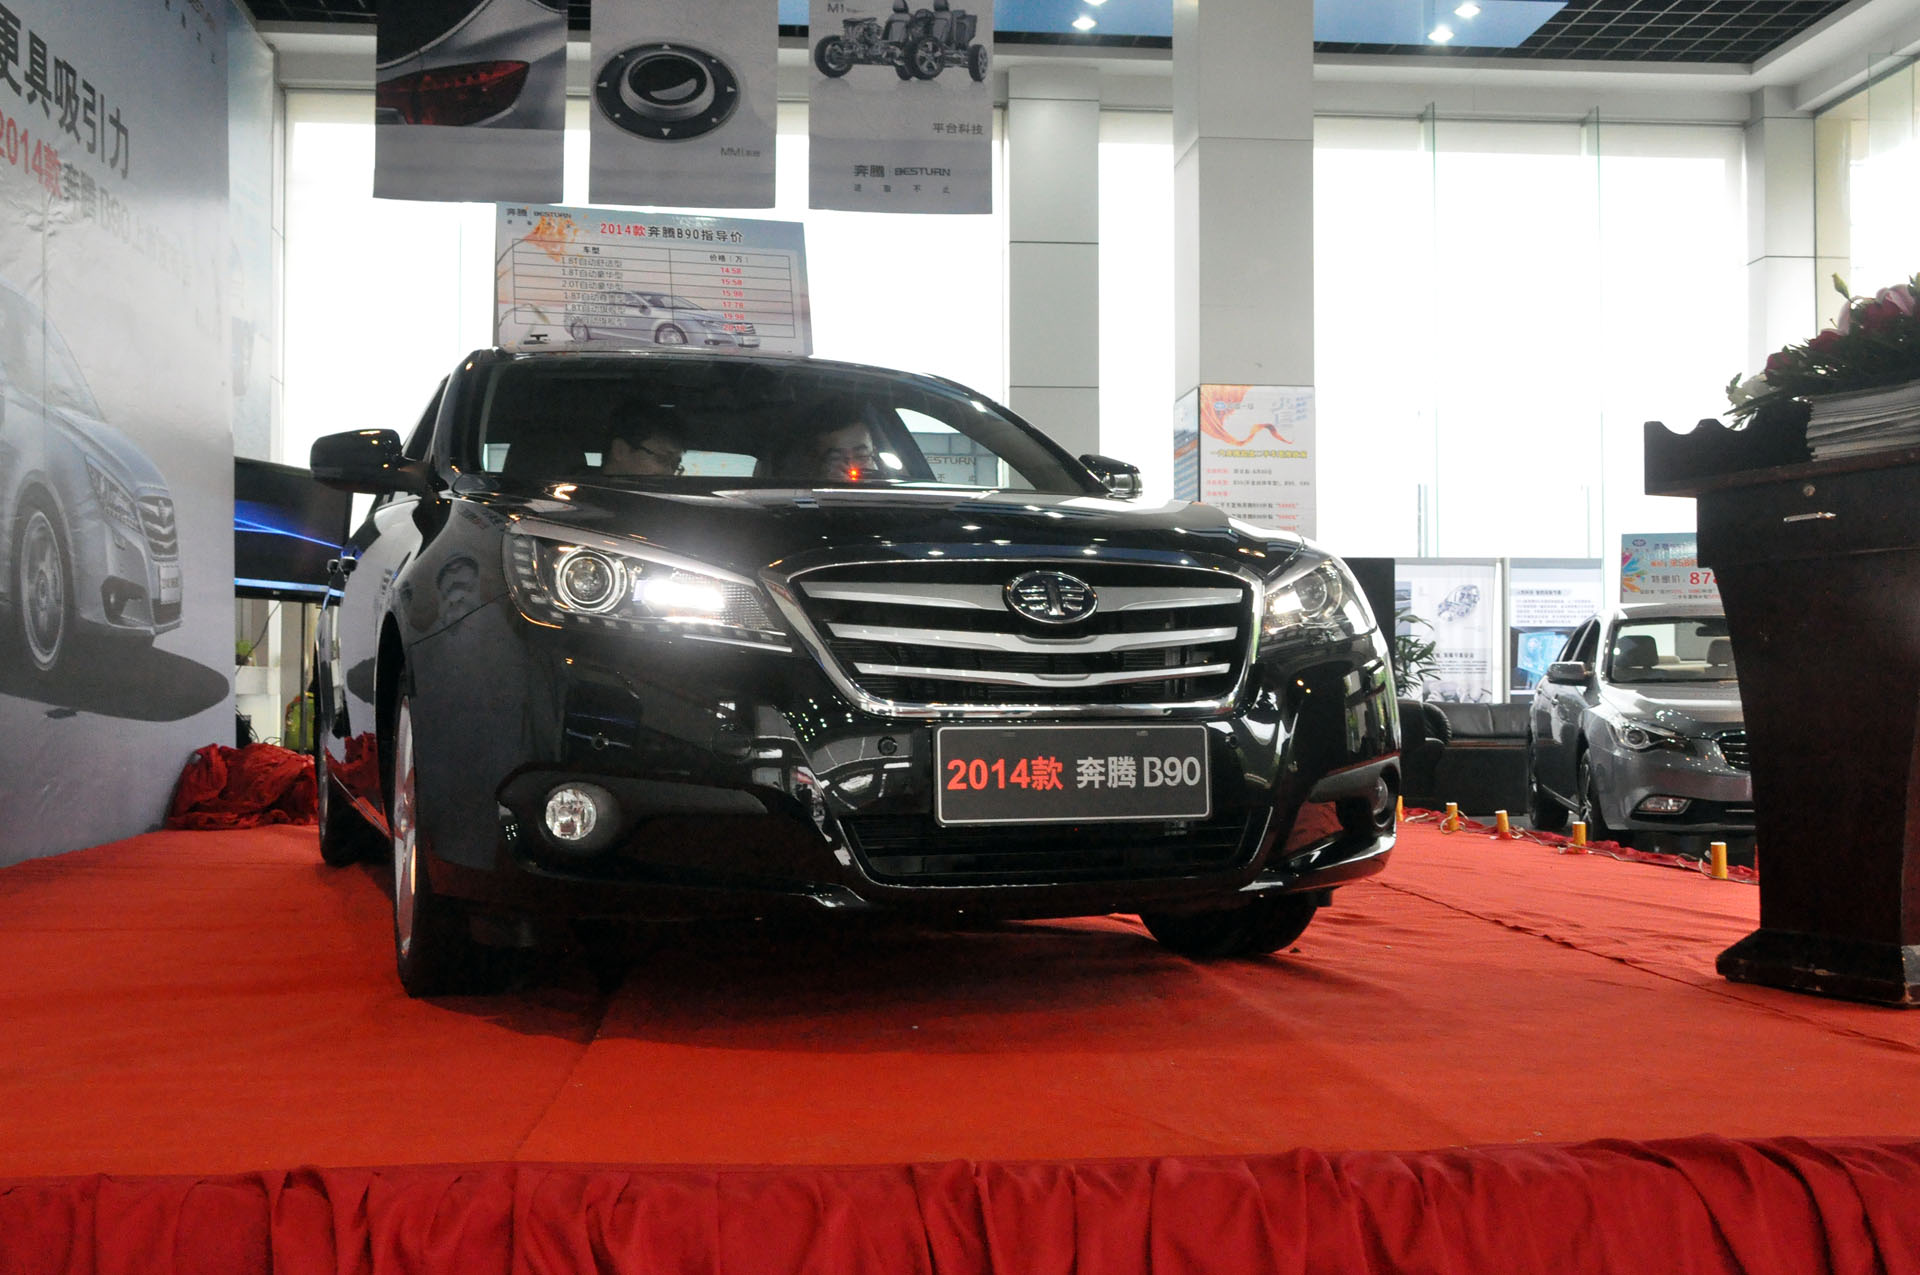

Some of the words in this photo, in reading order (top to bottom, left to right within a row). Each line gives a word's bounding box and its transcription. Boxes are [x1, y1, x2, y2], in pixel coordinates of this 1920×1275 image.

[0, 3, 130, 180] 更具吸引力
[932, 122, 984, 135] 平台科技
[854, 165, 885, 178] 奔腾
[894, 167, 951, 177] BESTURN
[600, 223, 743, 243] 2014款奔腾B90指导价
[947, 756, 1064, 791] 2014款
[1076, 756, 1201, 789] 奔腾B90
